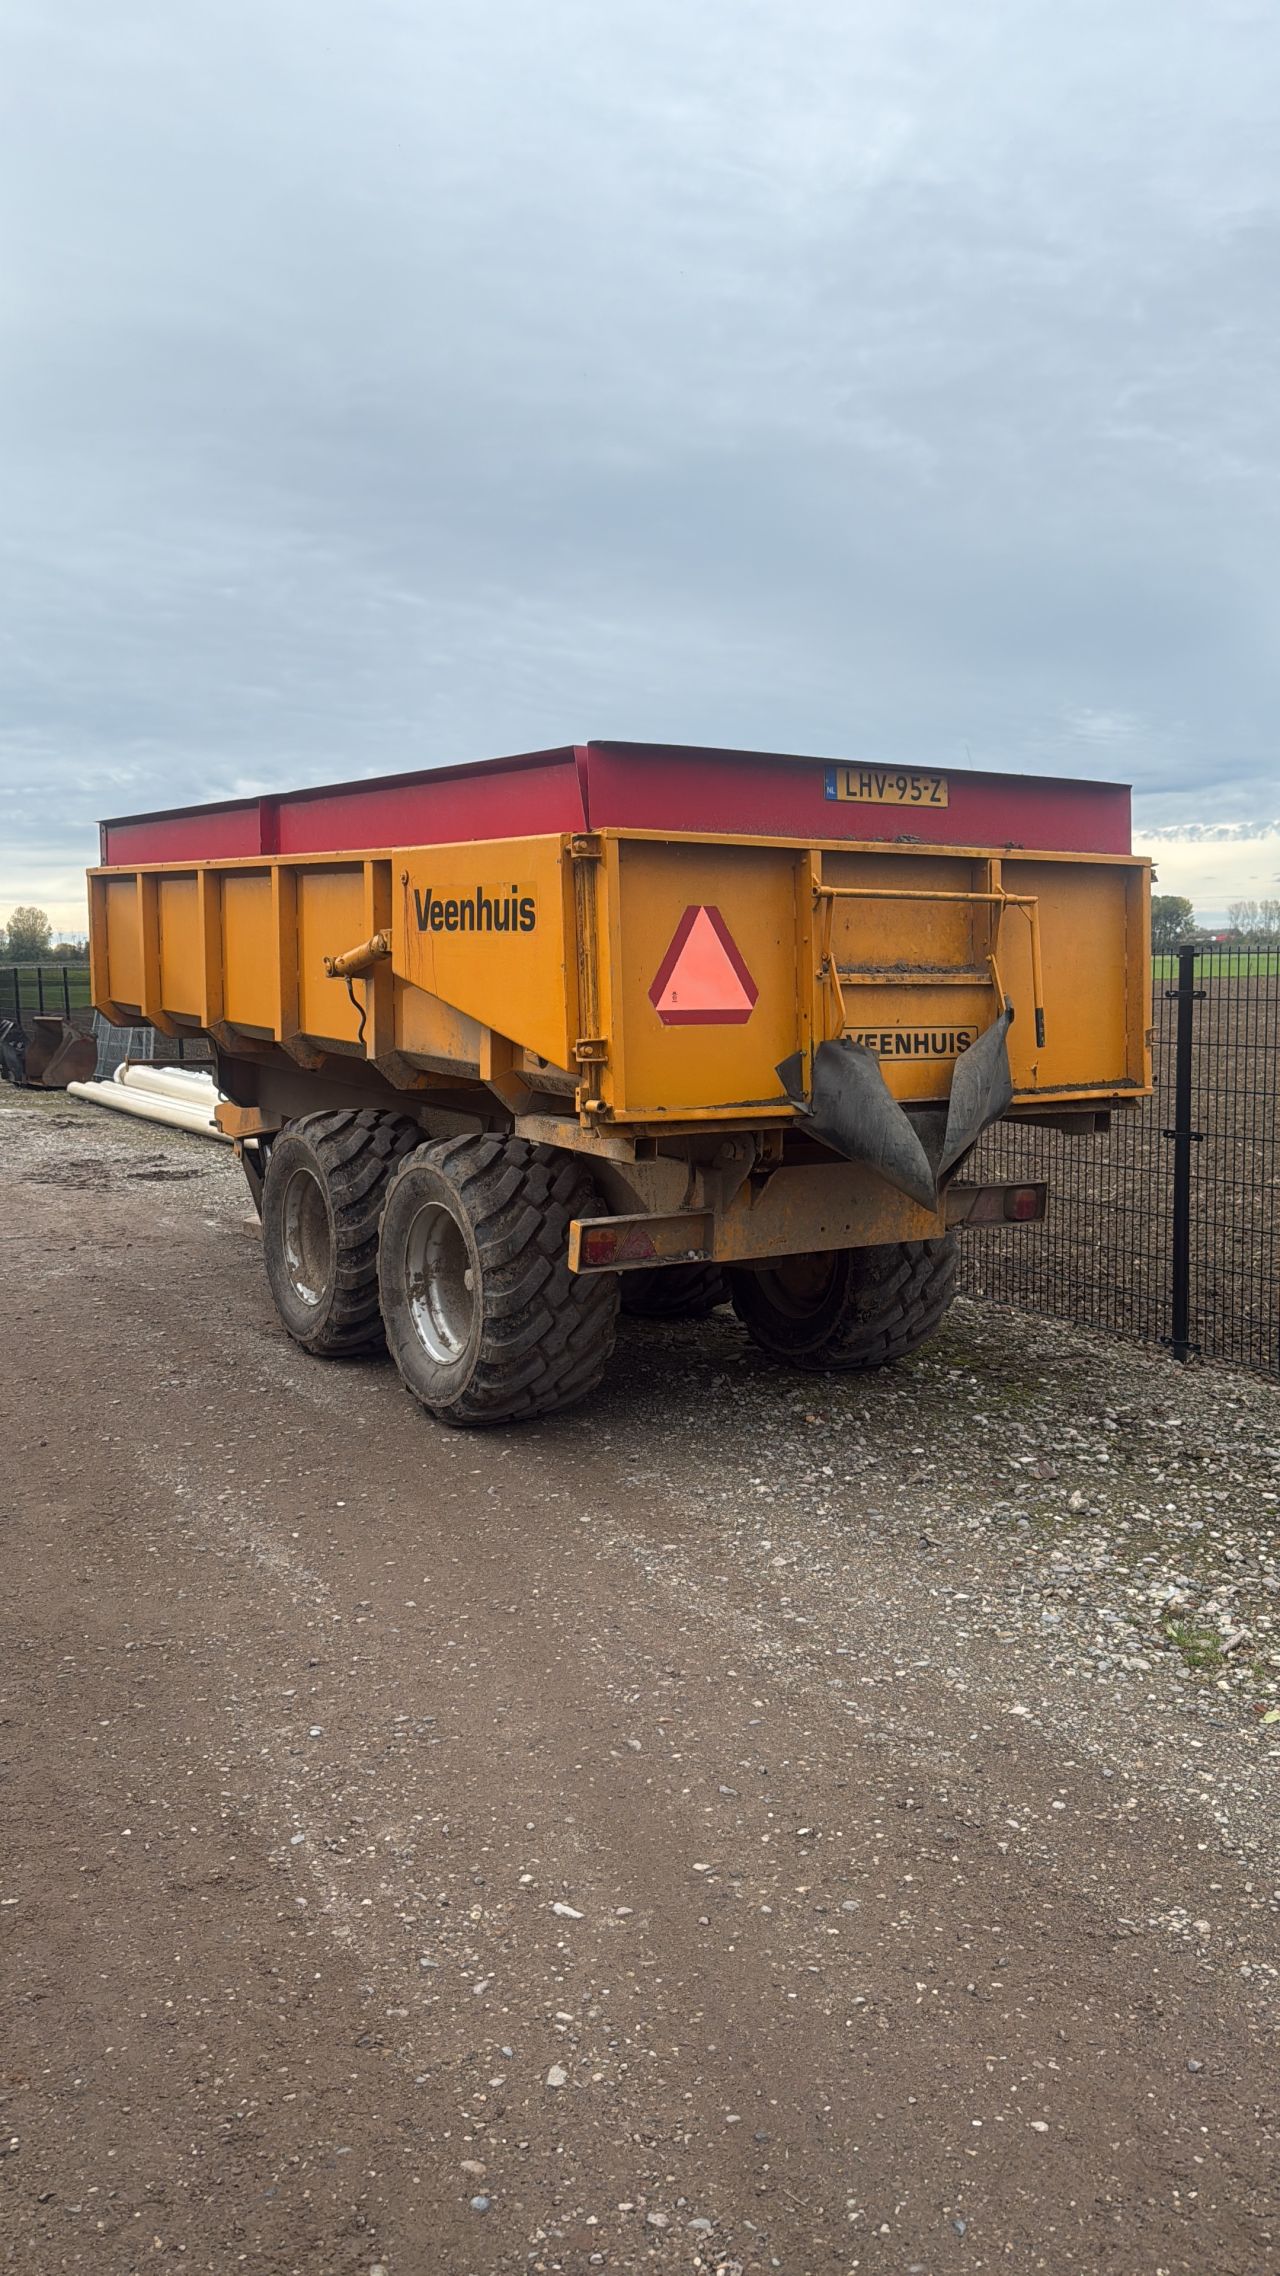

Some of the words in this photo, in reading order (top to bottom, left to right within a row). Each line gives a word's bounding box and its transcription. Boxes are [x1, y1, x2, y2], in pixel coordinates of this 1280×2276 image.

[826, 786, 836, 794] NL
[846, 771, 942, 803] LHV-95-Z
[414, 884, 536, 932] Veenhuis
